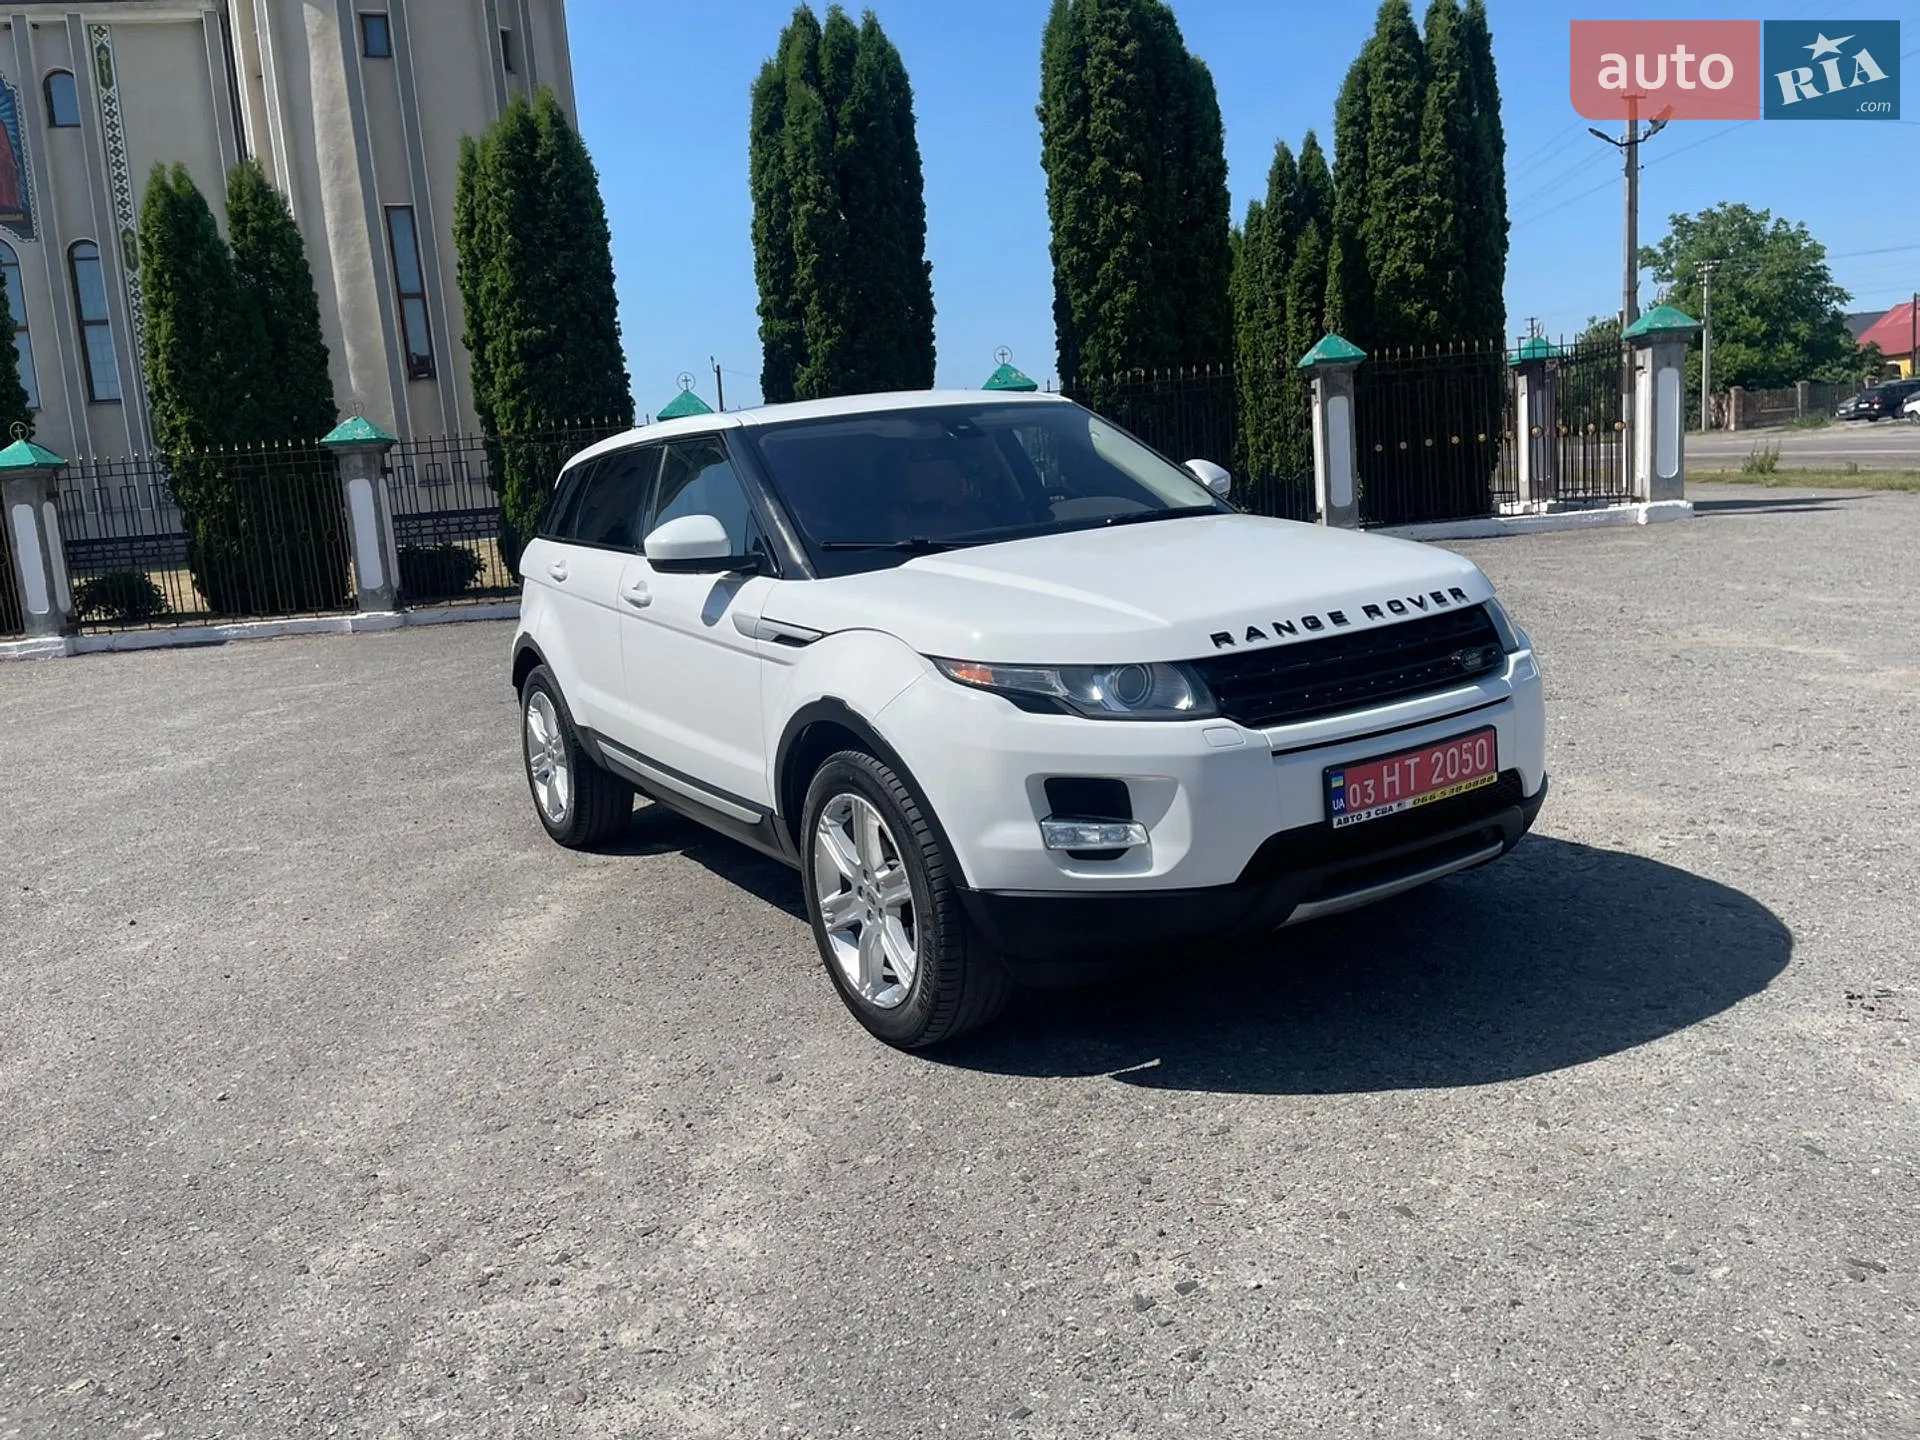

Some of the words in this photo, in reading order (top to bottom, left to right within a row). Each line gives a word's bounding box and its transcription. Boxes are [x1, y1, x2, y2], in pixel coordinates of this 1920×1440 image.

[1210, 610, 1350, 649] RANGE
[1361, 587, 1471, 621] ROVER
[1349, 779, 1376, 808] 03
[1382, 757, 1420, 798] HT
[1431, 738, 1488, 785] 2050
[1333, 799, 1345, 811] UA
